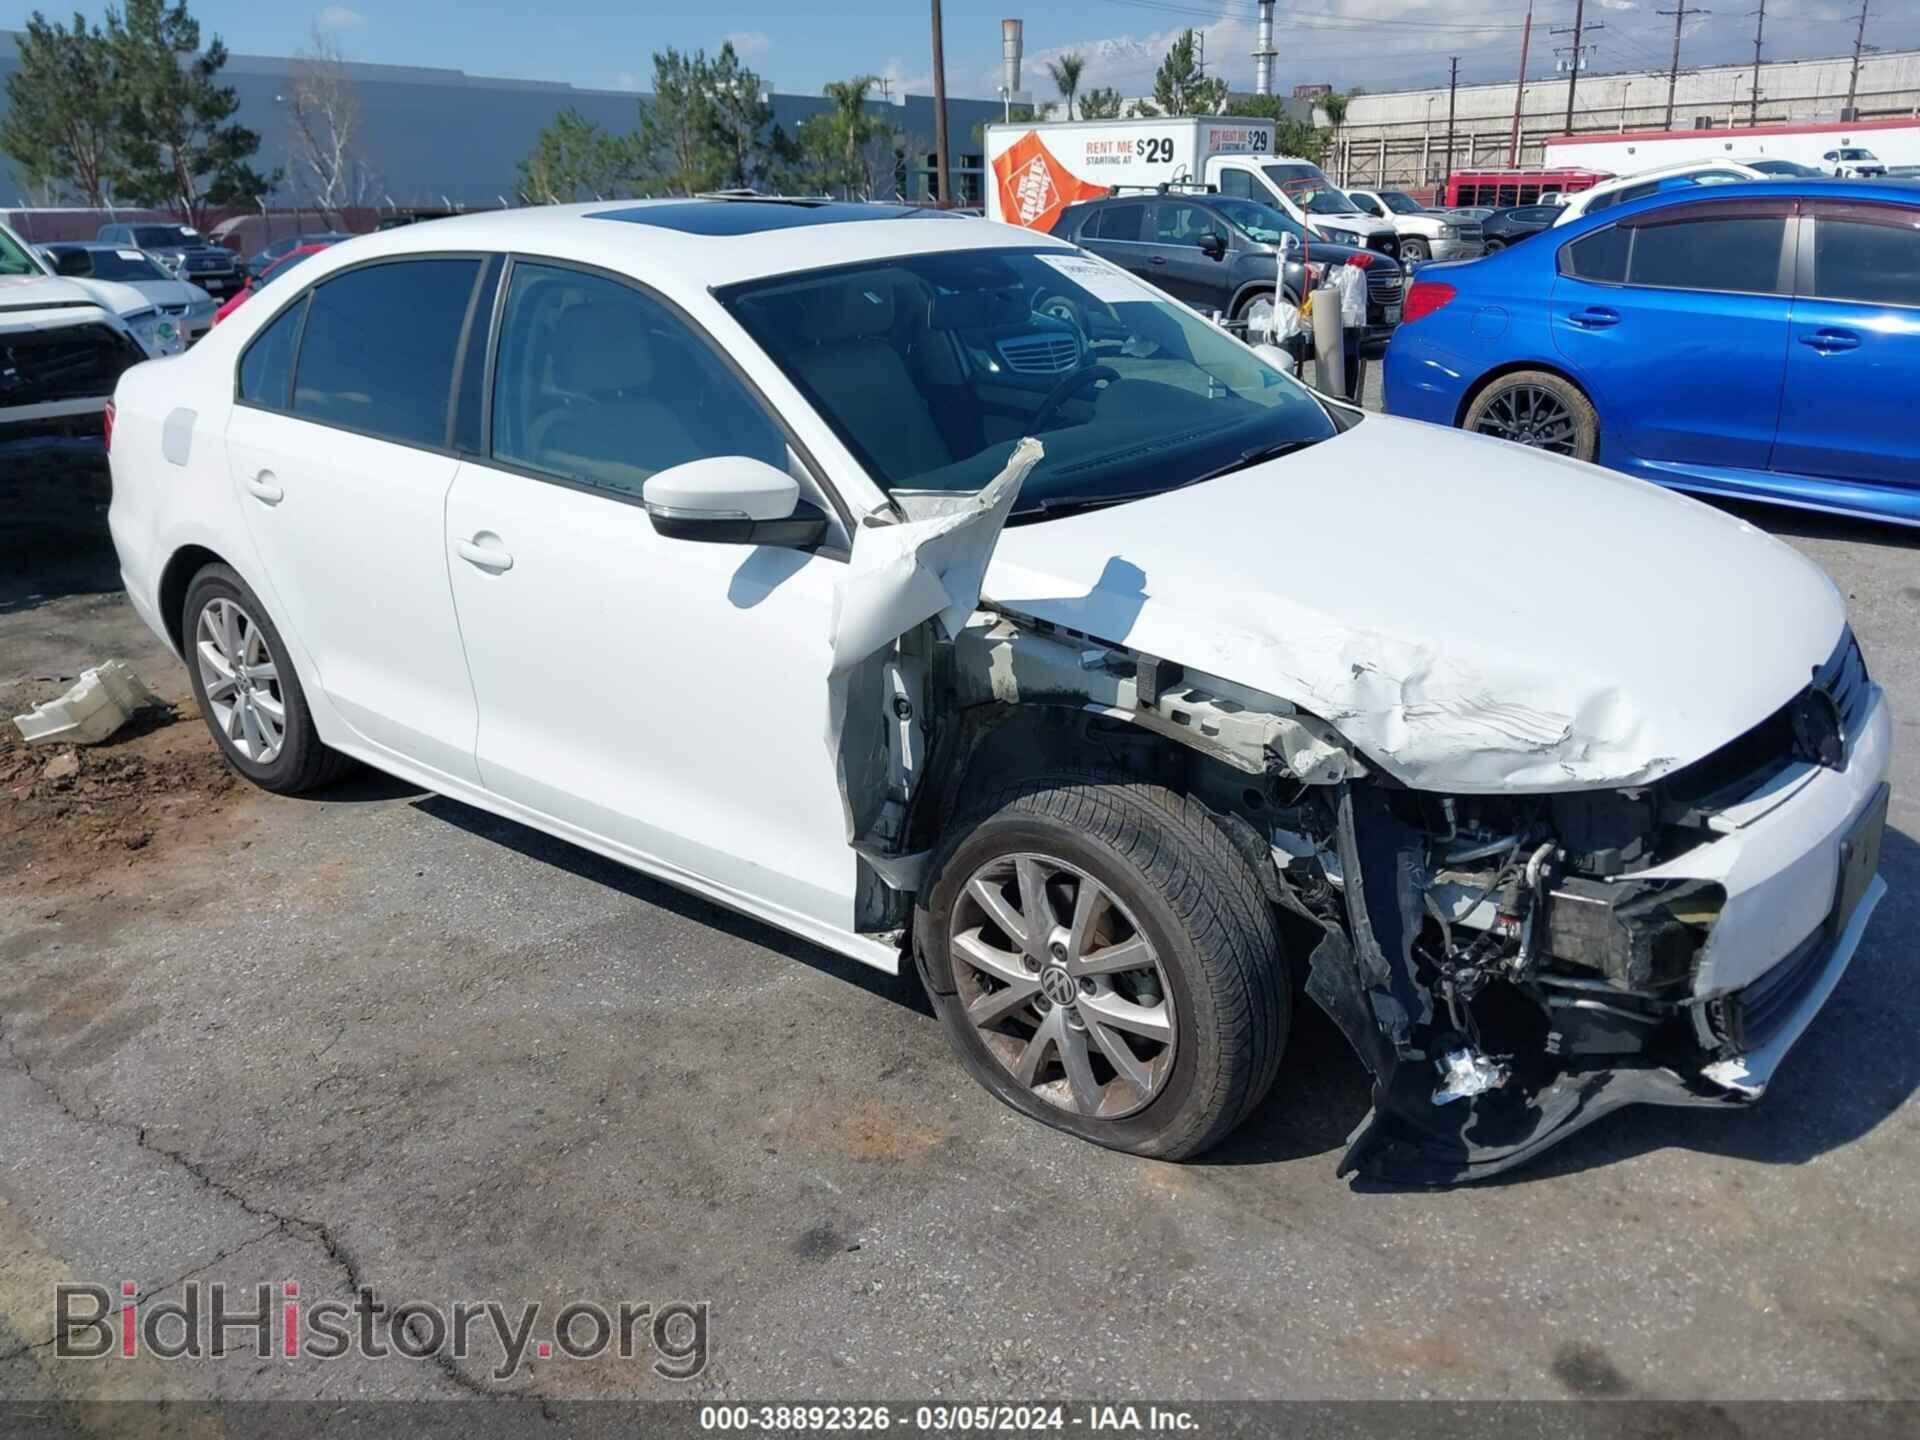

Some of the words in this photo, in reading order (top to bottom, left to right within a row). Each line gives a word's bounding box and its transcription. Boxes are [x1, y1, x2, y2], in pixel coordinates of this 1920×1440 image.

[1086, 141, 1113, 154] RENT
[1117, 140, 1133, 153] ME
[1136, 137, 1174, 163] $29
[1248, 130, 1268, 151] $29
[1086, 155, 1121, 166] STARTING
[1122, 155, 1133, 165] AT
[1022, 157, 1043, 221] HOME
